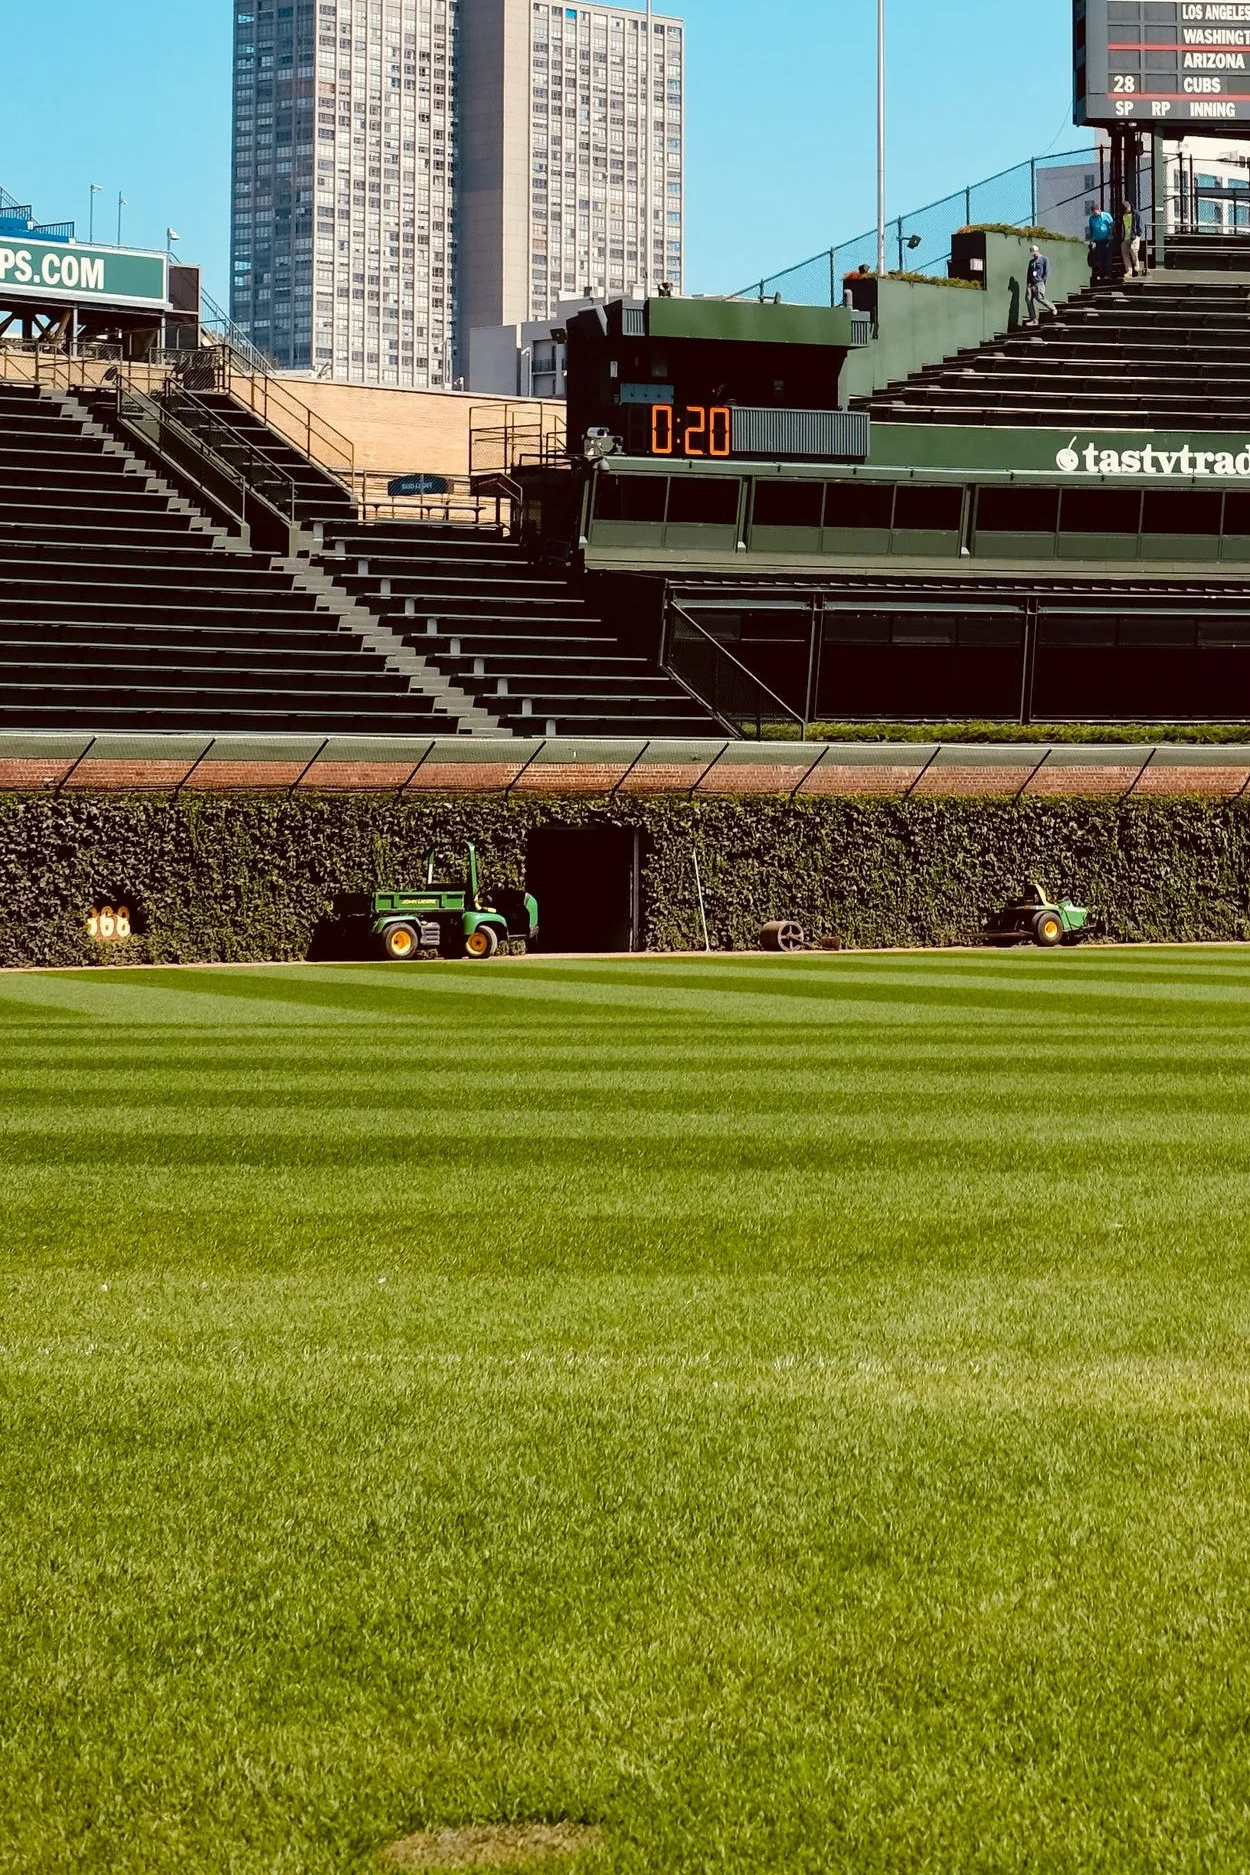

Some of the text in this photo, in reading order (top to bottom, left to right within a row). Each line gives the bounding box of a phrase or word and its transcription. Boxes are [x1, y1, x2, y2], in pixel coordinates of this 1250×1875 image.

[1183, 5, 1202, 19] LOS
[1184, 53, 1245, 68] ARIZONA
[1114, 76, 1220, 93] 28 CUBS
[1116, 101, 1235, 117] SP RP INNING
[652, 405, 729, 455] 0:20
